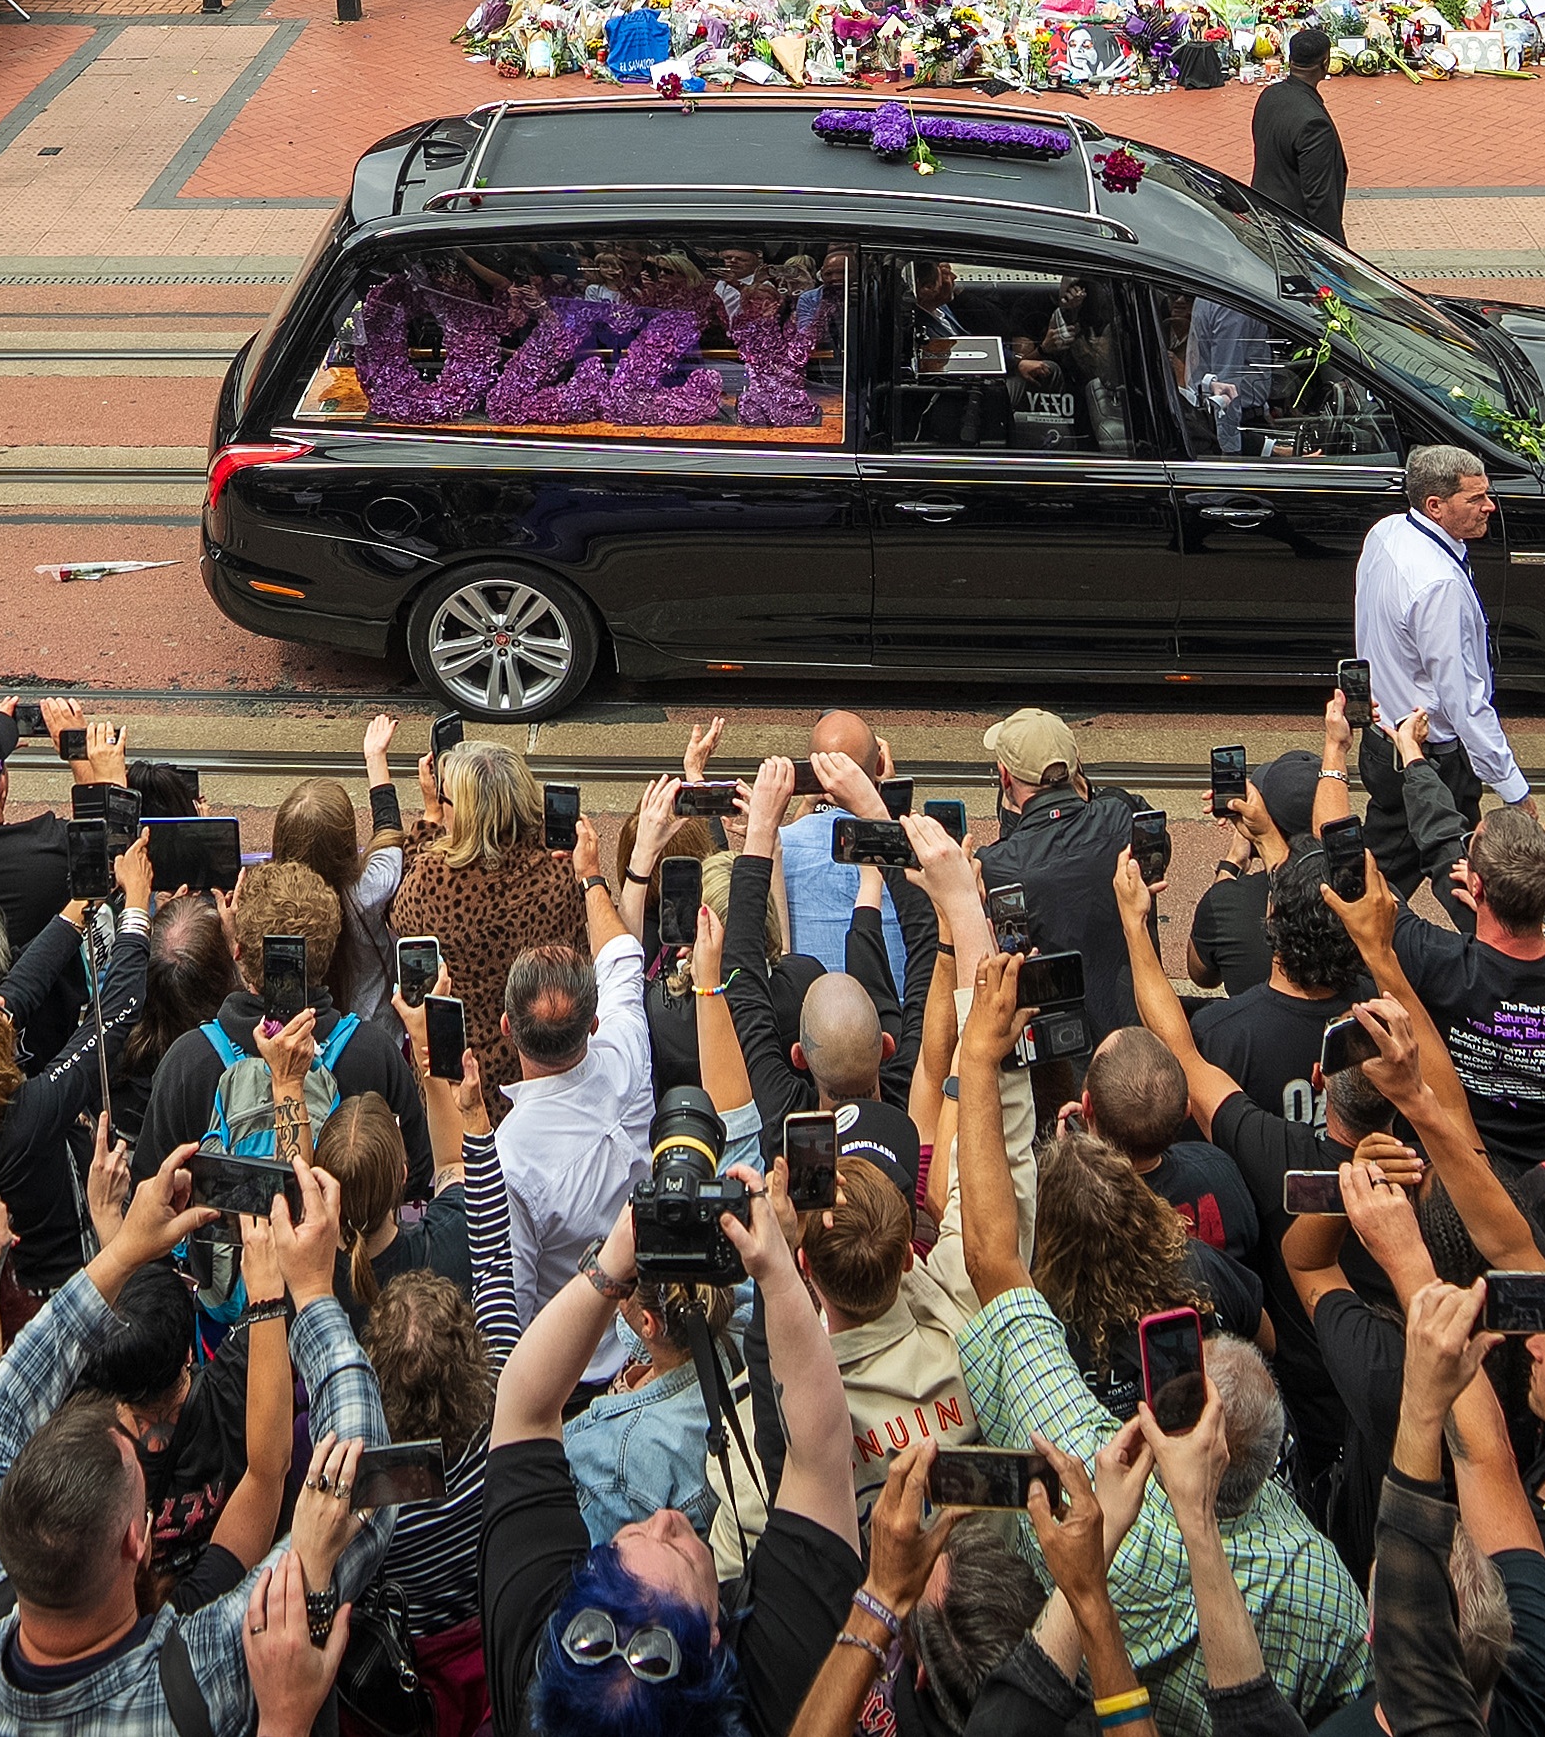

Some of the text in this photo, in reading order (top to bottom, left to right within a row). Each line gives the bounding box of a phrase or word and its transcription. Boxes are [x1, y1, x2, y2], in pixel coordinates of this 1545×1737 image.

[1501, 1001, 1516, 1012] The
[1516, 1002, 1540, 1015] Final
[1466, 1017, 1492, 1037] Villa
[1493, 1023, 1523, 1040] Park,
[1493, 1011, 1539, 1028] Saturday
[1540, 1016, 1545, 1027] 5
[1449, 1035, 1497, 1056] METALLICA
[1450, 1026, 1481, 1044] BLACK
[1482, 1036, 1526, 1057] SABBATH
